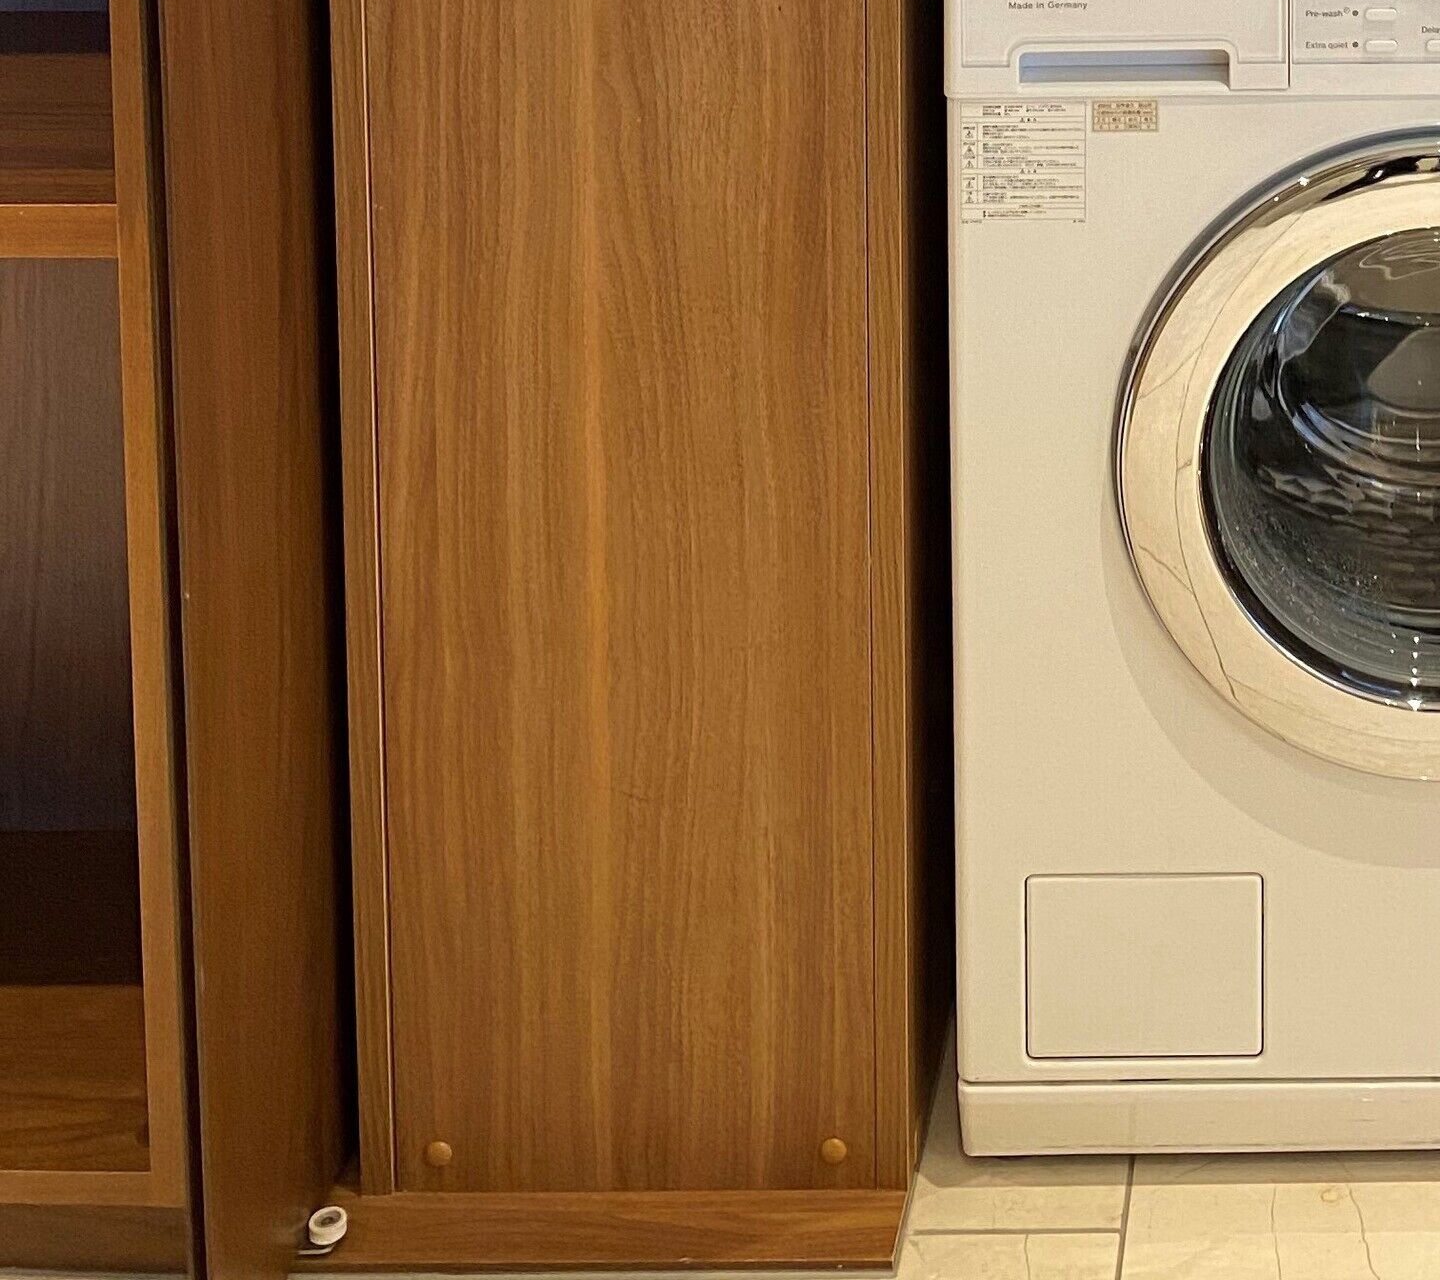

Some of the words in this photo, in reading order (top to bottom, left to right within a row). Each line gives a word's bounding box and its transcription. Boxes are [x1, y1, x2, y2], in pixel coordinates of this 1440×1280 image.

[1008, 1, 1033, 10] Made
[1047, 0, 1088, 10] Germany
[1305, 41, 1327, 49] Extra
